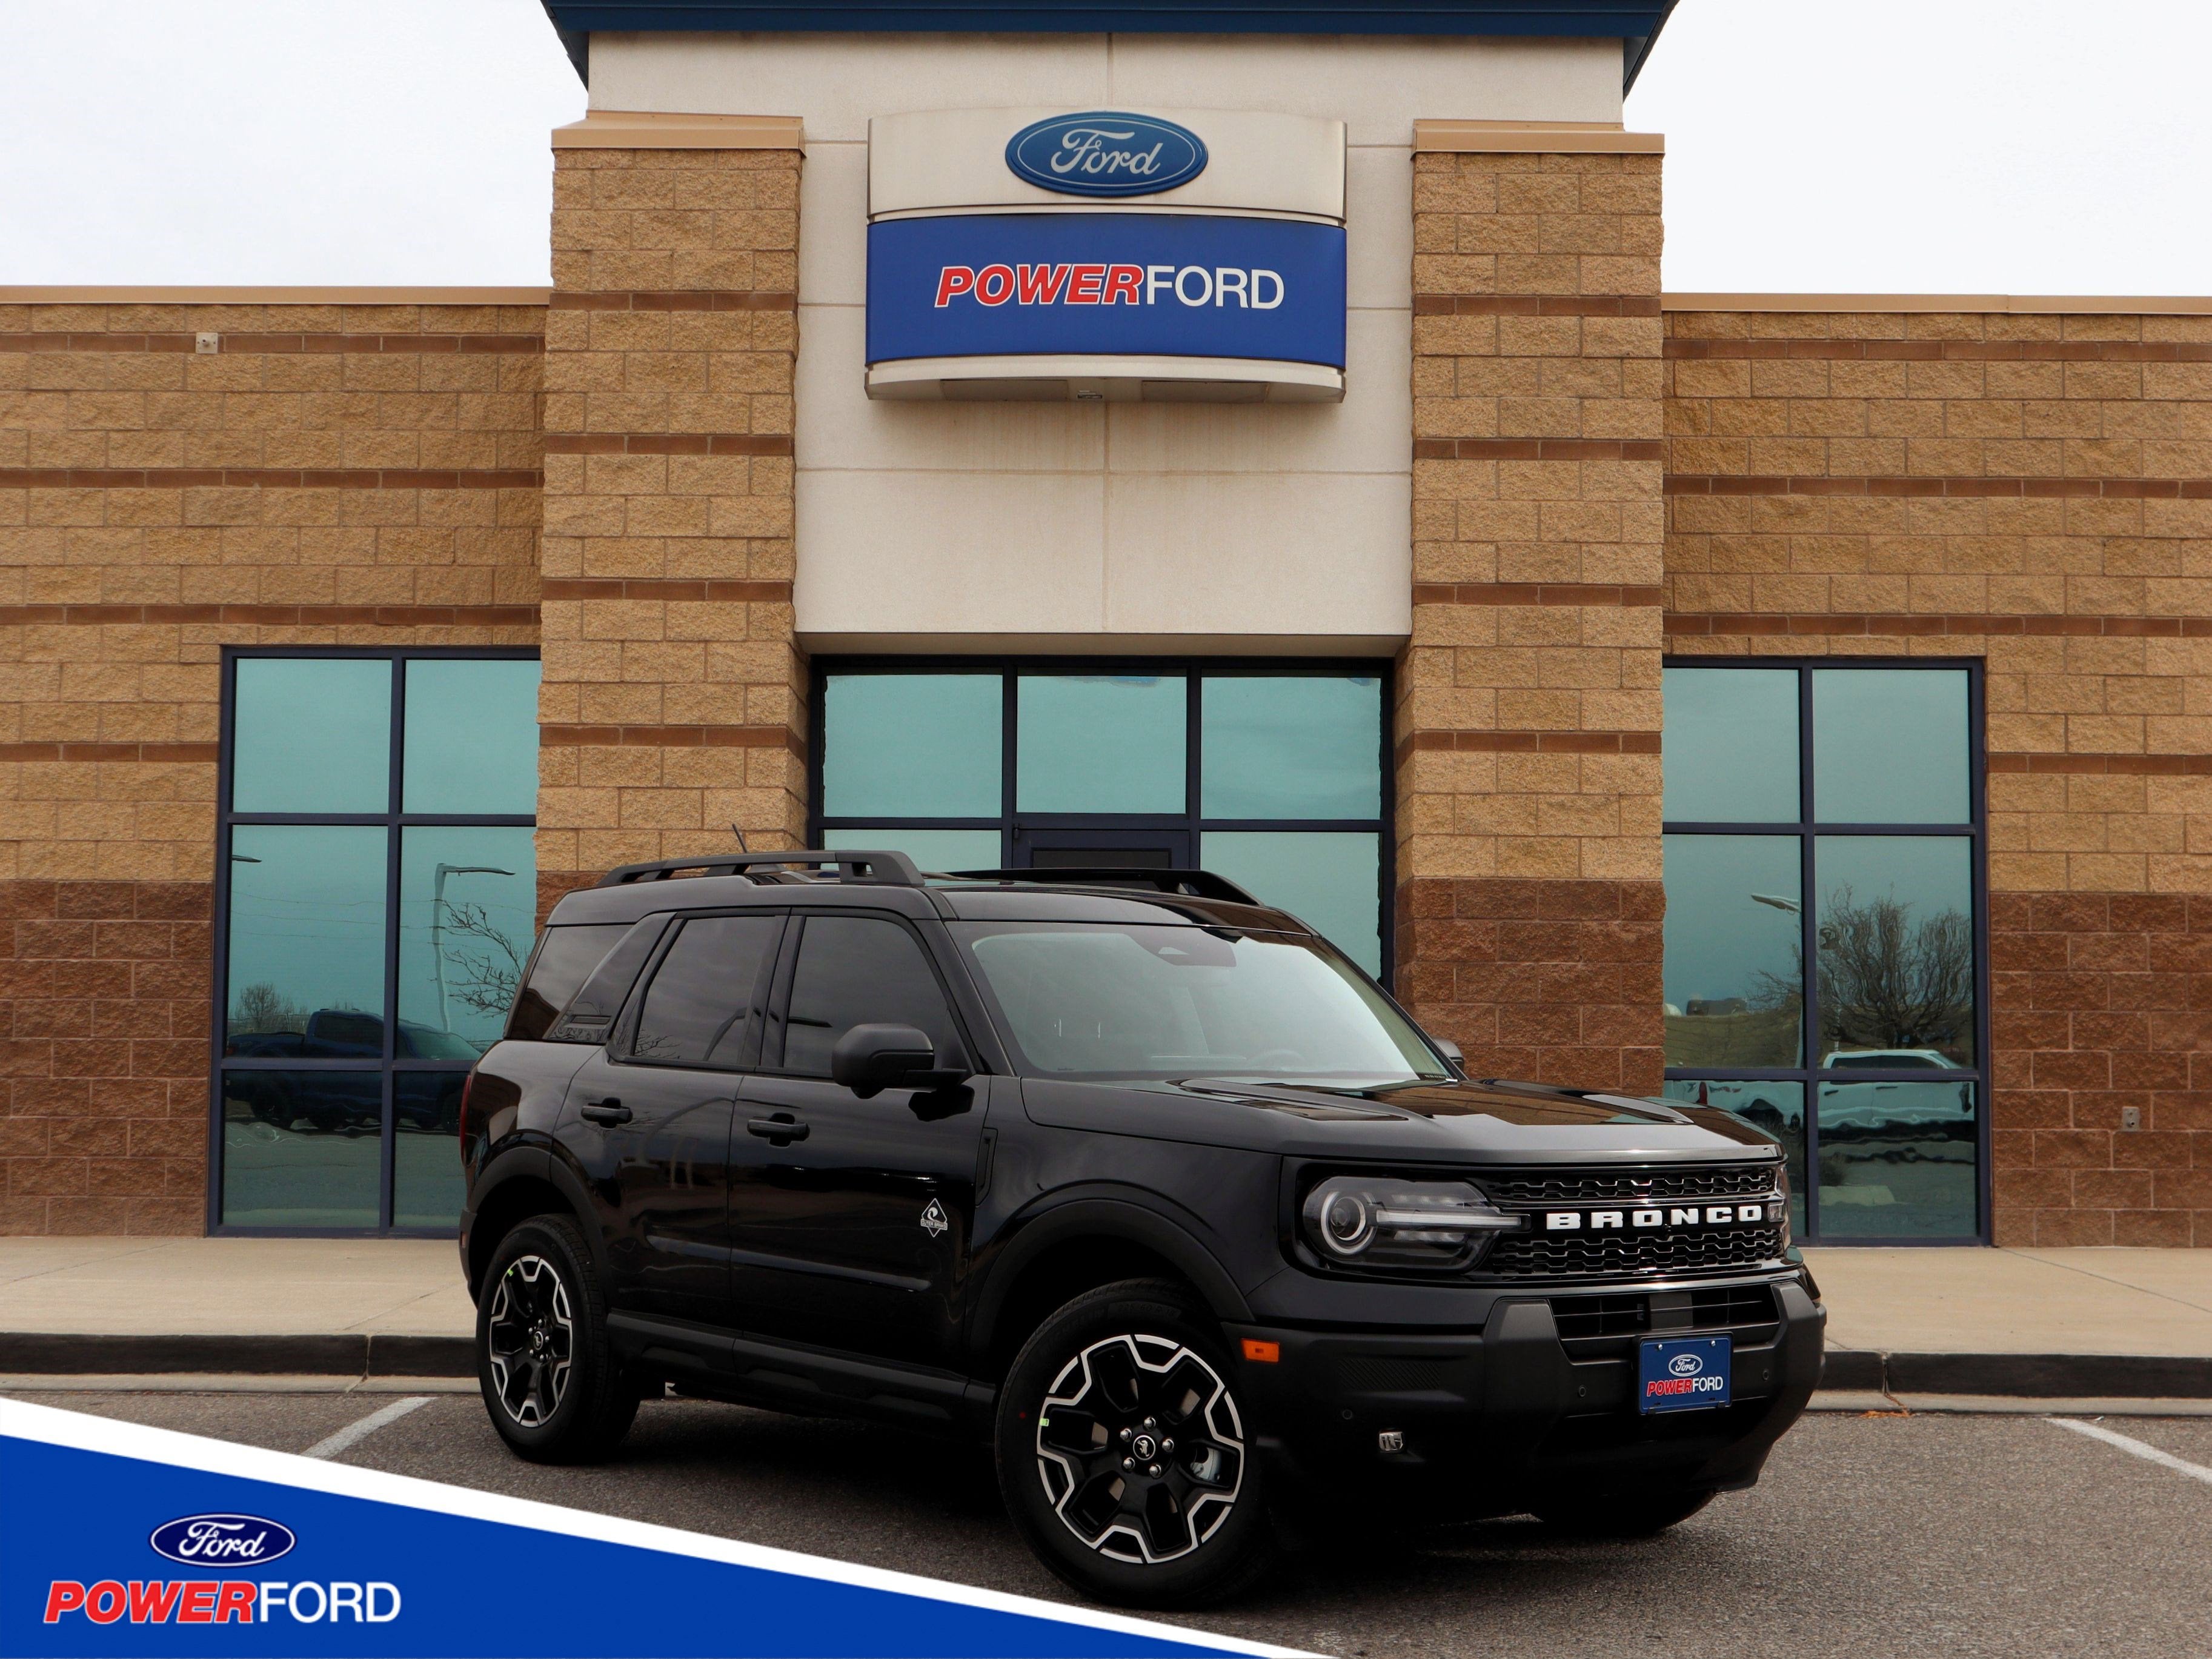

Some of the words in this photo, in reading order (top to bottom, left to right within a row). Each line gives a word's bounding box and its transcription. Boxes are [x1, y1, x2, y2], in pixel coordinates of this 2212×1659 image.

[1051, 128, 1164, 176] Ford
[1546, 1205, 1762, 1230] BRONCO
[1675, 1358, 1696, 1372] Ford
